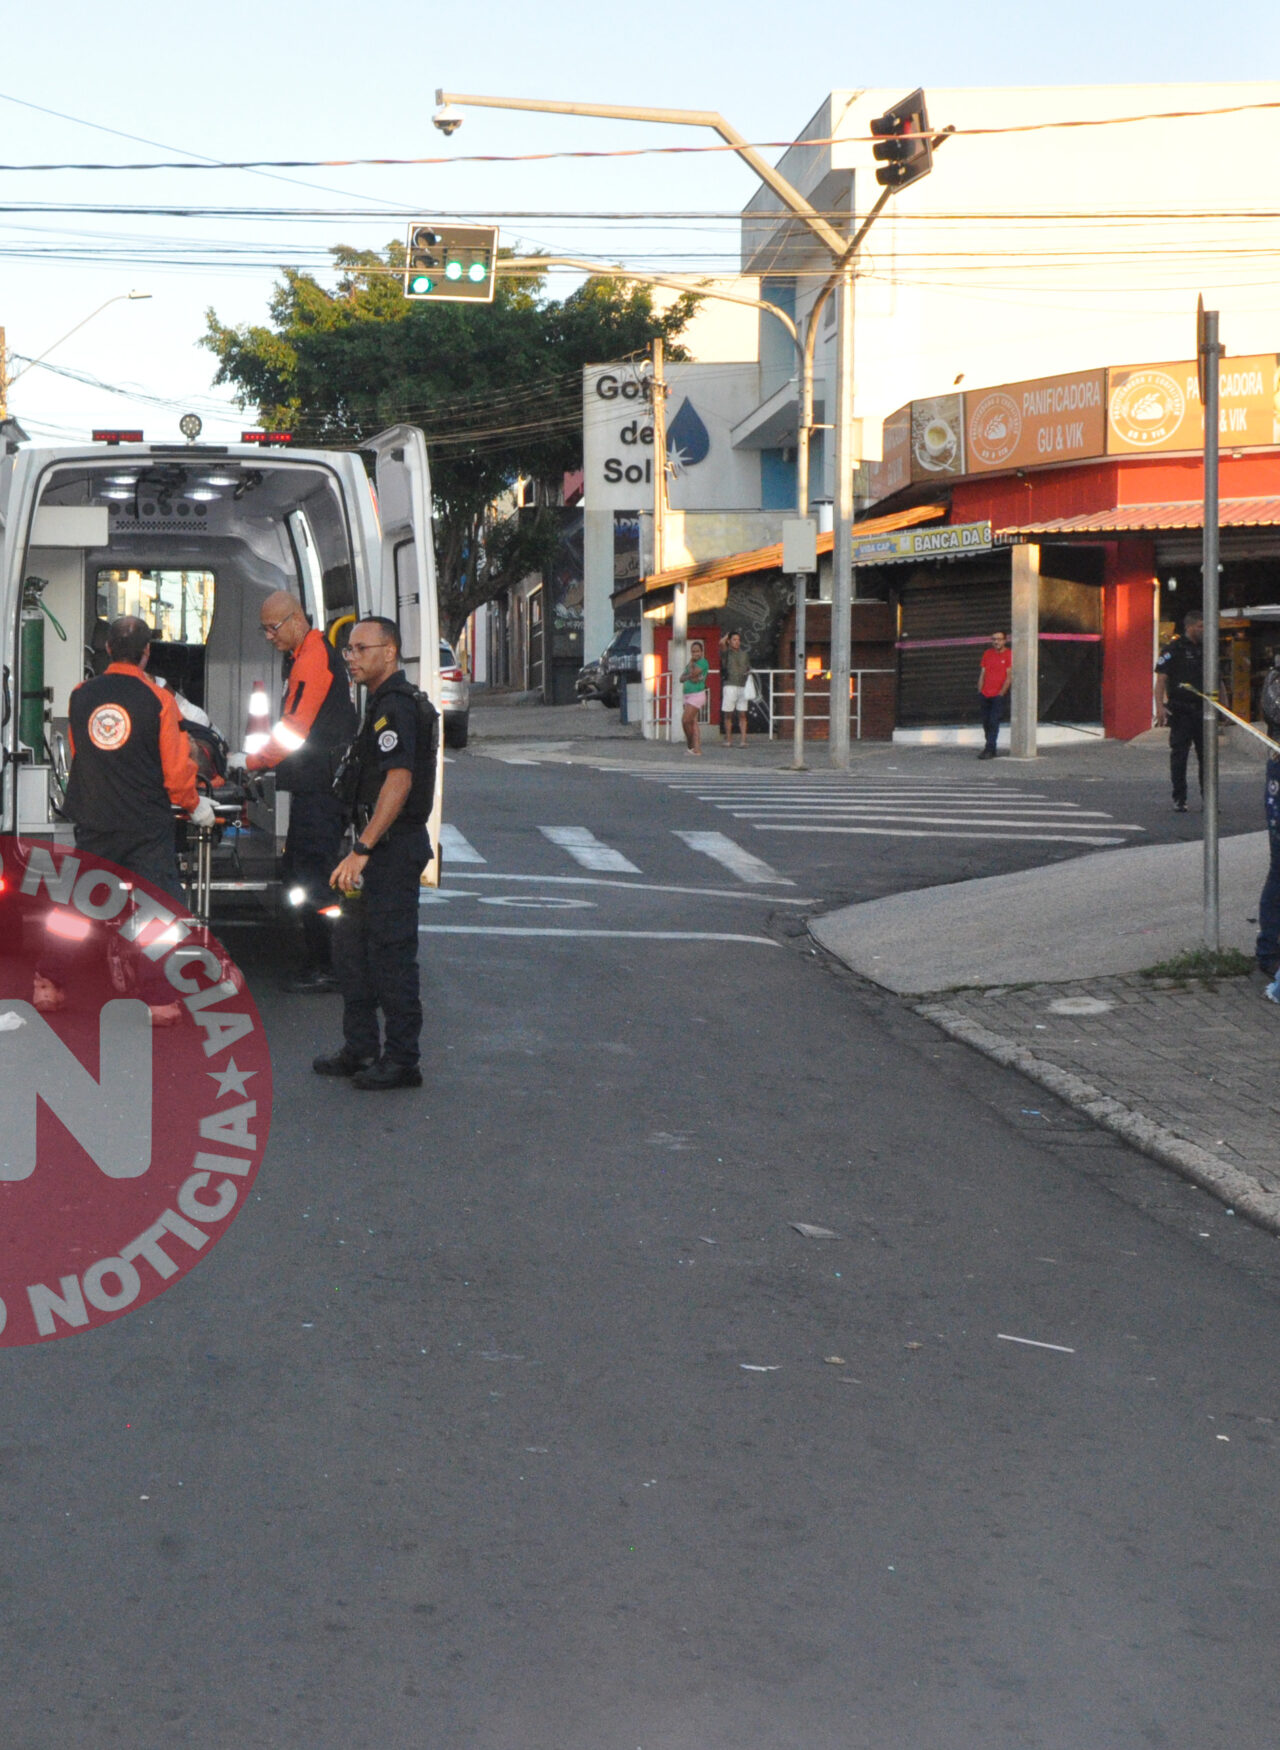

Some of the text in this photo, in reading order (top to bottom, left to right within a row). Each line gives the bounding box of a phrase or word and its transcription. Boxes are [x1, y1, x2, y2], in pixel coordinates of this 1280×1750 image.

[1186, 371, 1264, 400] PACADORA
[1023, 381, 1101, 418] PANIFICADORA
[1229, 408, 1247, 431] VIK
[620, 420, 654, 445] de
[1037, 423, 1084, 453] GU & VIK
[603, 458, 651, 483] Sol
[914, 532, 959, 551] BANCA
[962, 530, 980, 546] DA
